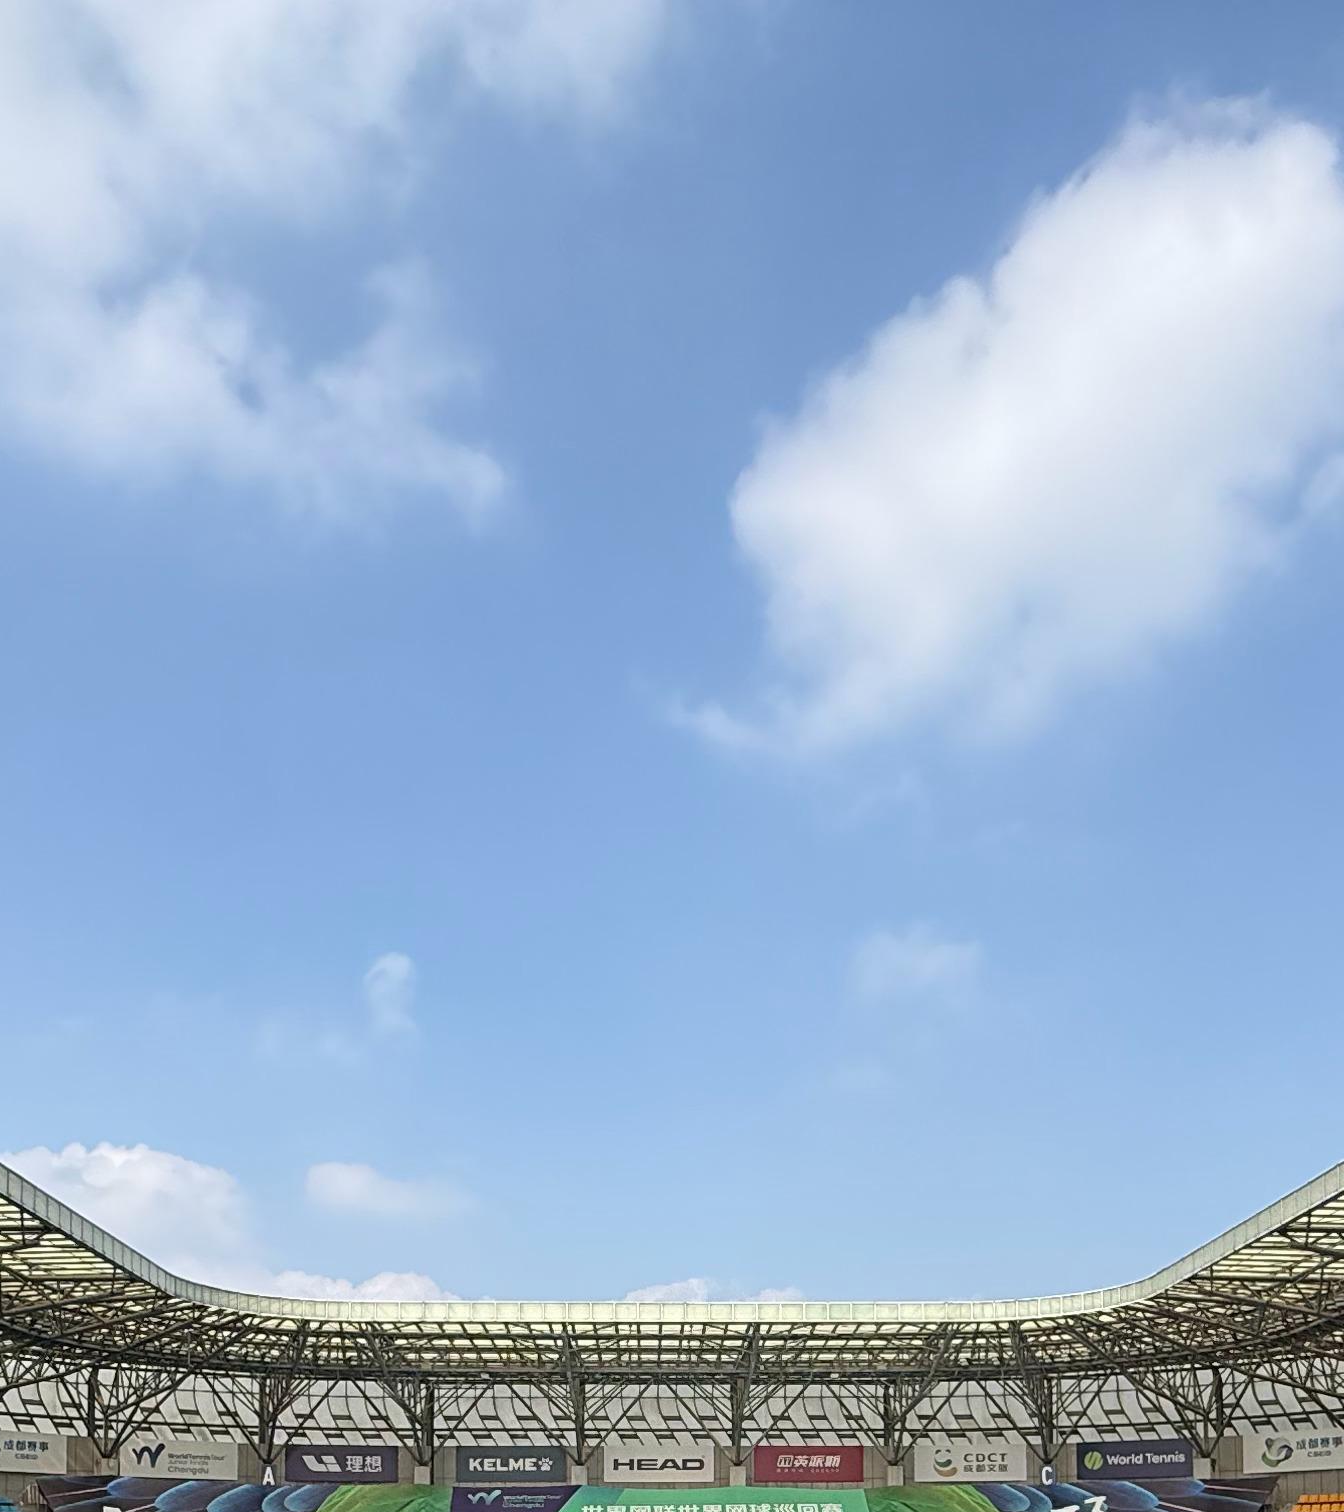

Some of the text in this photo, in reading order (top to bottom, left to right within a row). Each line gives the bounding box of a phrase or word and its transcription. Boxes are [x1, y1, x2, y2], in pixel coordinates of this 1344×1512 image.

[345, 1454, 383, 1472] 理想
[468, 1458, 537, 1472] KELME
[613, 1457, 705, 1471] HEAD
[963, 1452, 1008, 1463] CDCT
[1106, 1450, 1186, 1466] World Tennis
[167, 1466, 209, 1476] Chengdu
[262, 1466, 276, 1486] A
[1041, 1466, 1053, 1486] C
